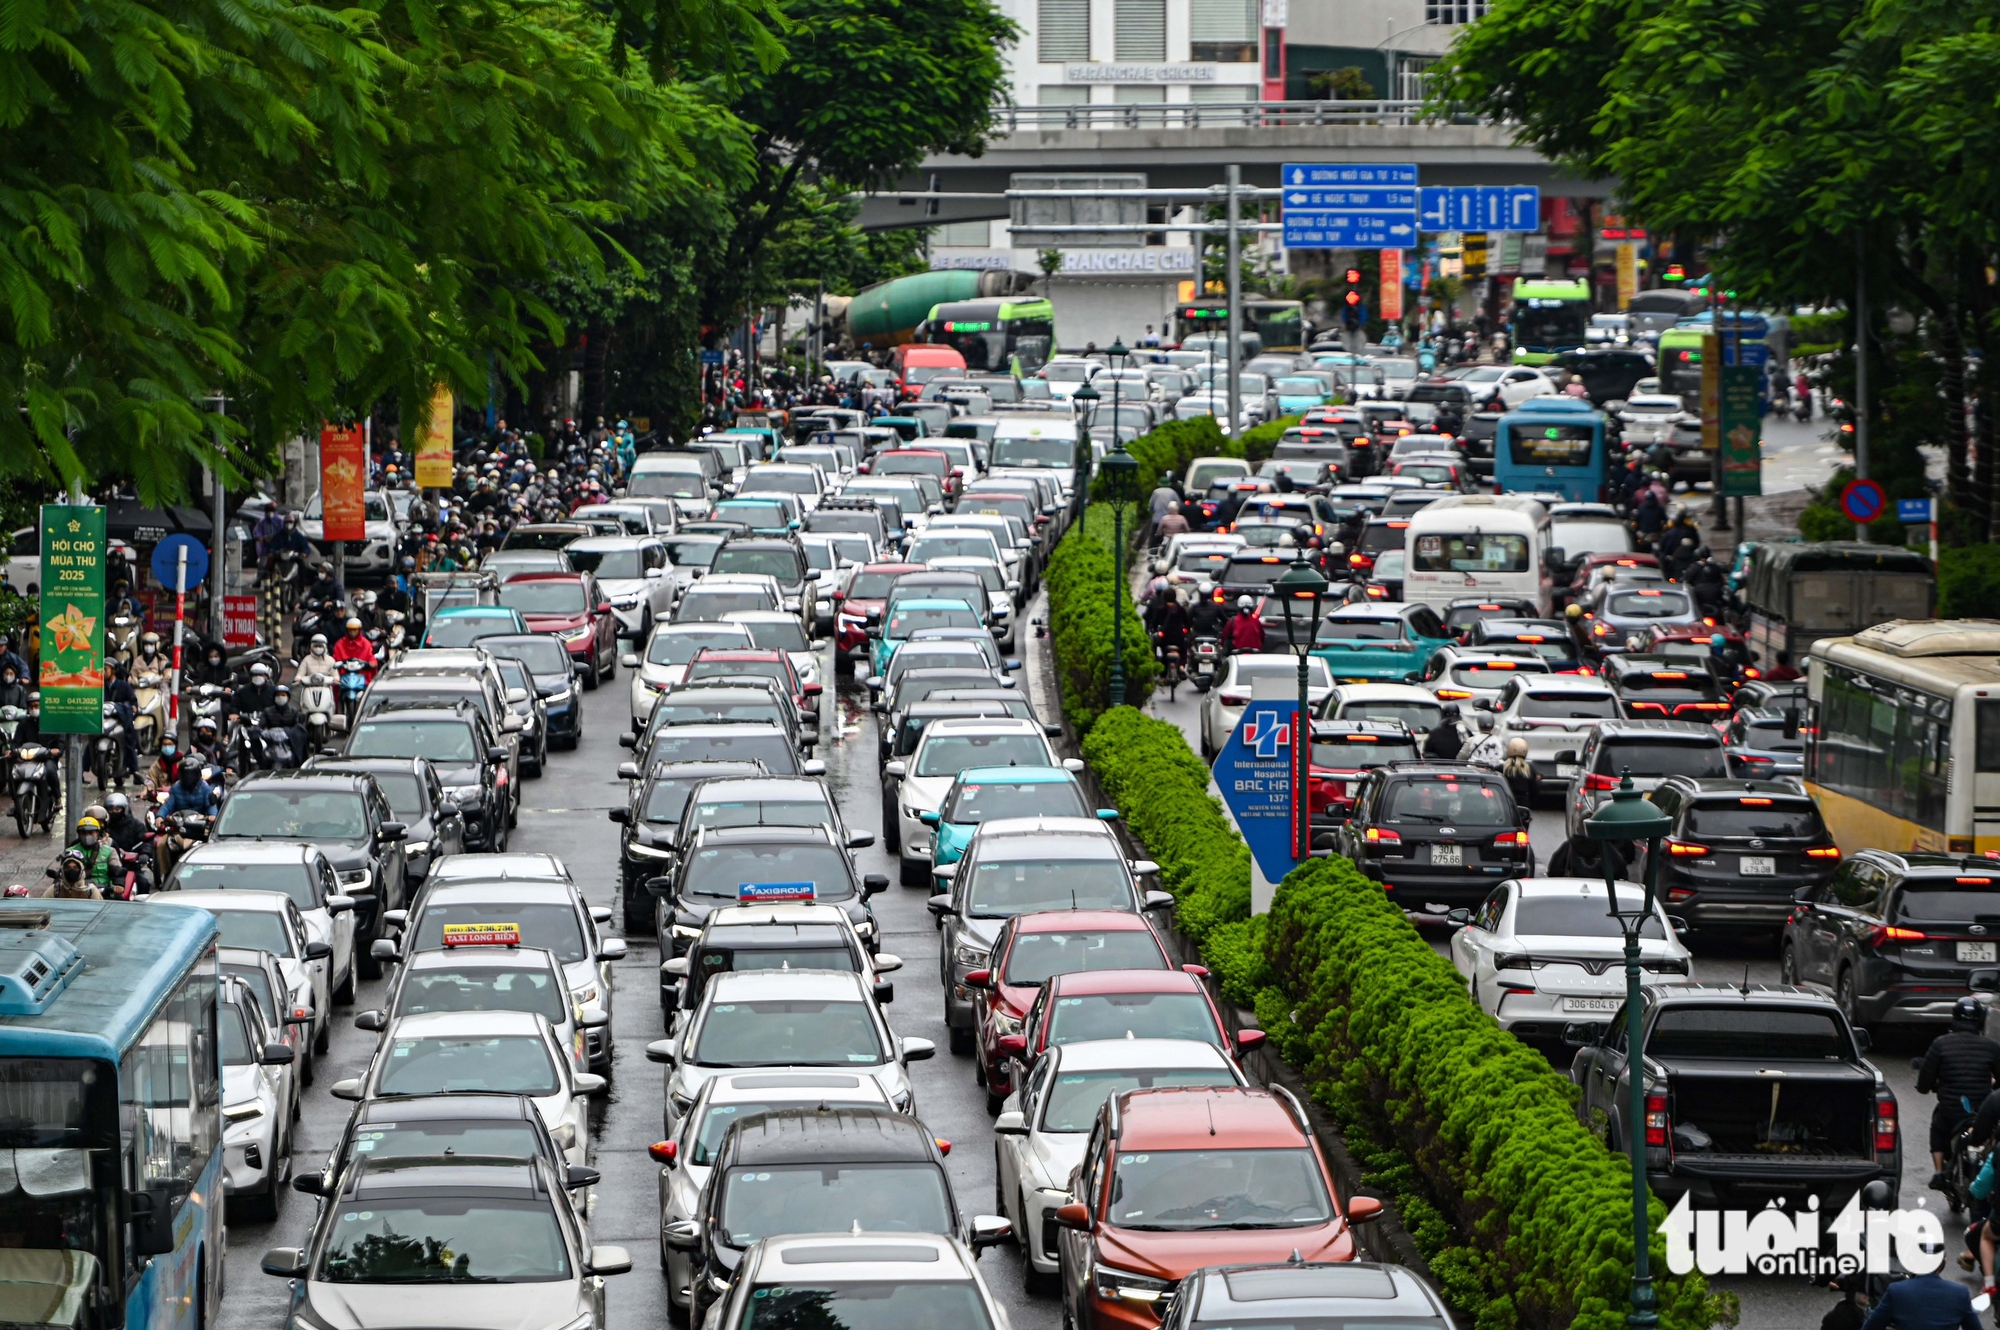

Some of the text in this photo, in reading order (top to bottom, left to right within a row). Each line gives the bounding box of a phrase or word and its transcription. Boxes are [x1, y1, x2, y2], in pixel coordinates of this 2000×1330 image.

[1400, 171, 1413, 180] km
[1399, 195, 1413, 204] km
[1371, 217, 1385, 227] km
[1371, 231, 1385, 242] km
[52, 539, 95, 552] HỘI CHỢ
[51, 554, 96, 566] MÙA THU
[59, 570, 85, 581] 2025
[1254, 770, 1289, 778] Hospital
[1438, 845, 1454, 854] 30A
[1433, 855, 1460, 864] 275.66
[751, 887, 811, 895] TAXIGROUP
[446, 934, 467, 942] TAXI
[1557, 978, 1624, 986] VINFAS
